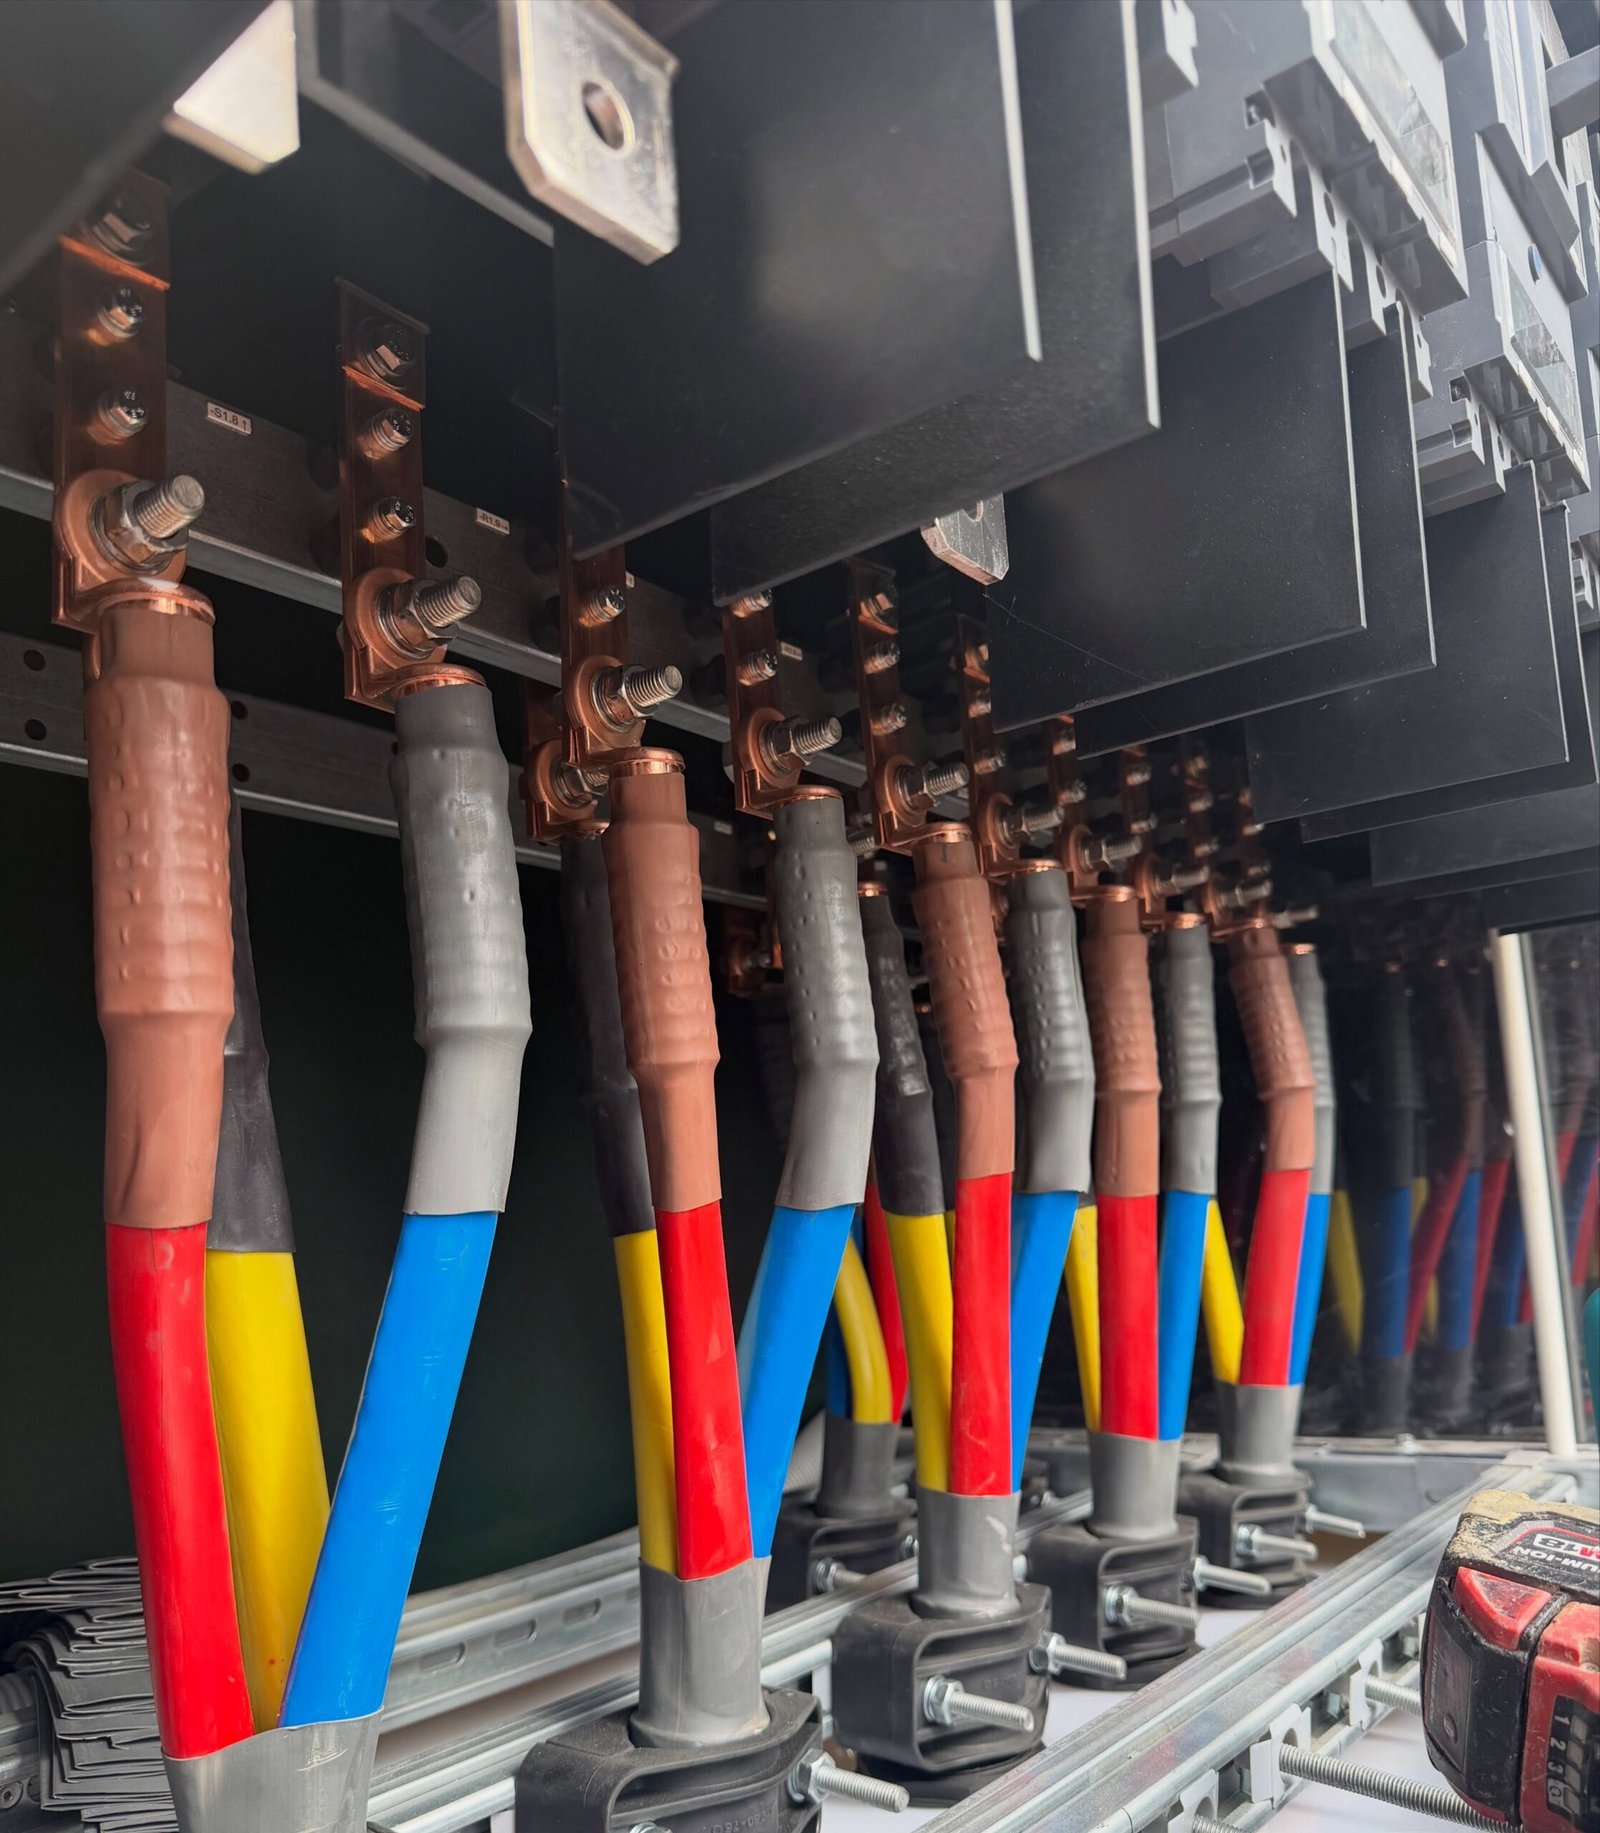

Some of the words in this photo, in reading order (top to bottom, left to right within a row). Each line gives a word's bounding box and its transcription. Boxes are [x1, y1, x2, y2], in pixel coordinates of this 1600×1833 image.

[1512, 1546, 1600, 1574] UM-ION
[1554, 1715, 1570, 1725] 1
[1550, 1736, 1567, 1751] 2
[1547, 1761, 1564, 1775] 3
